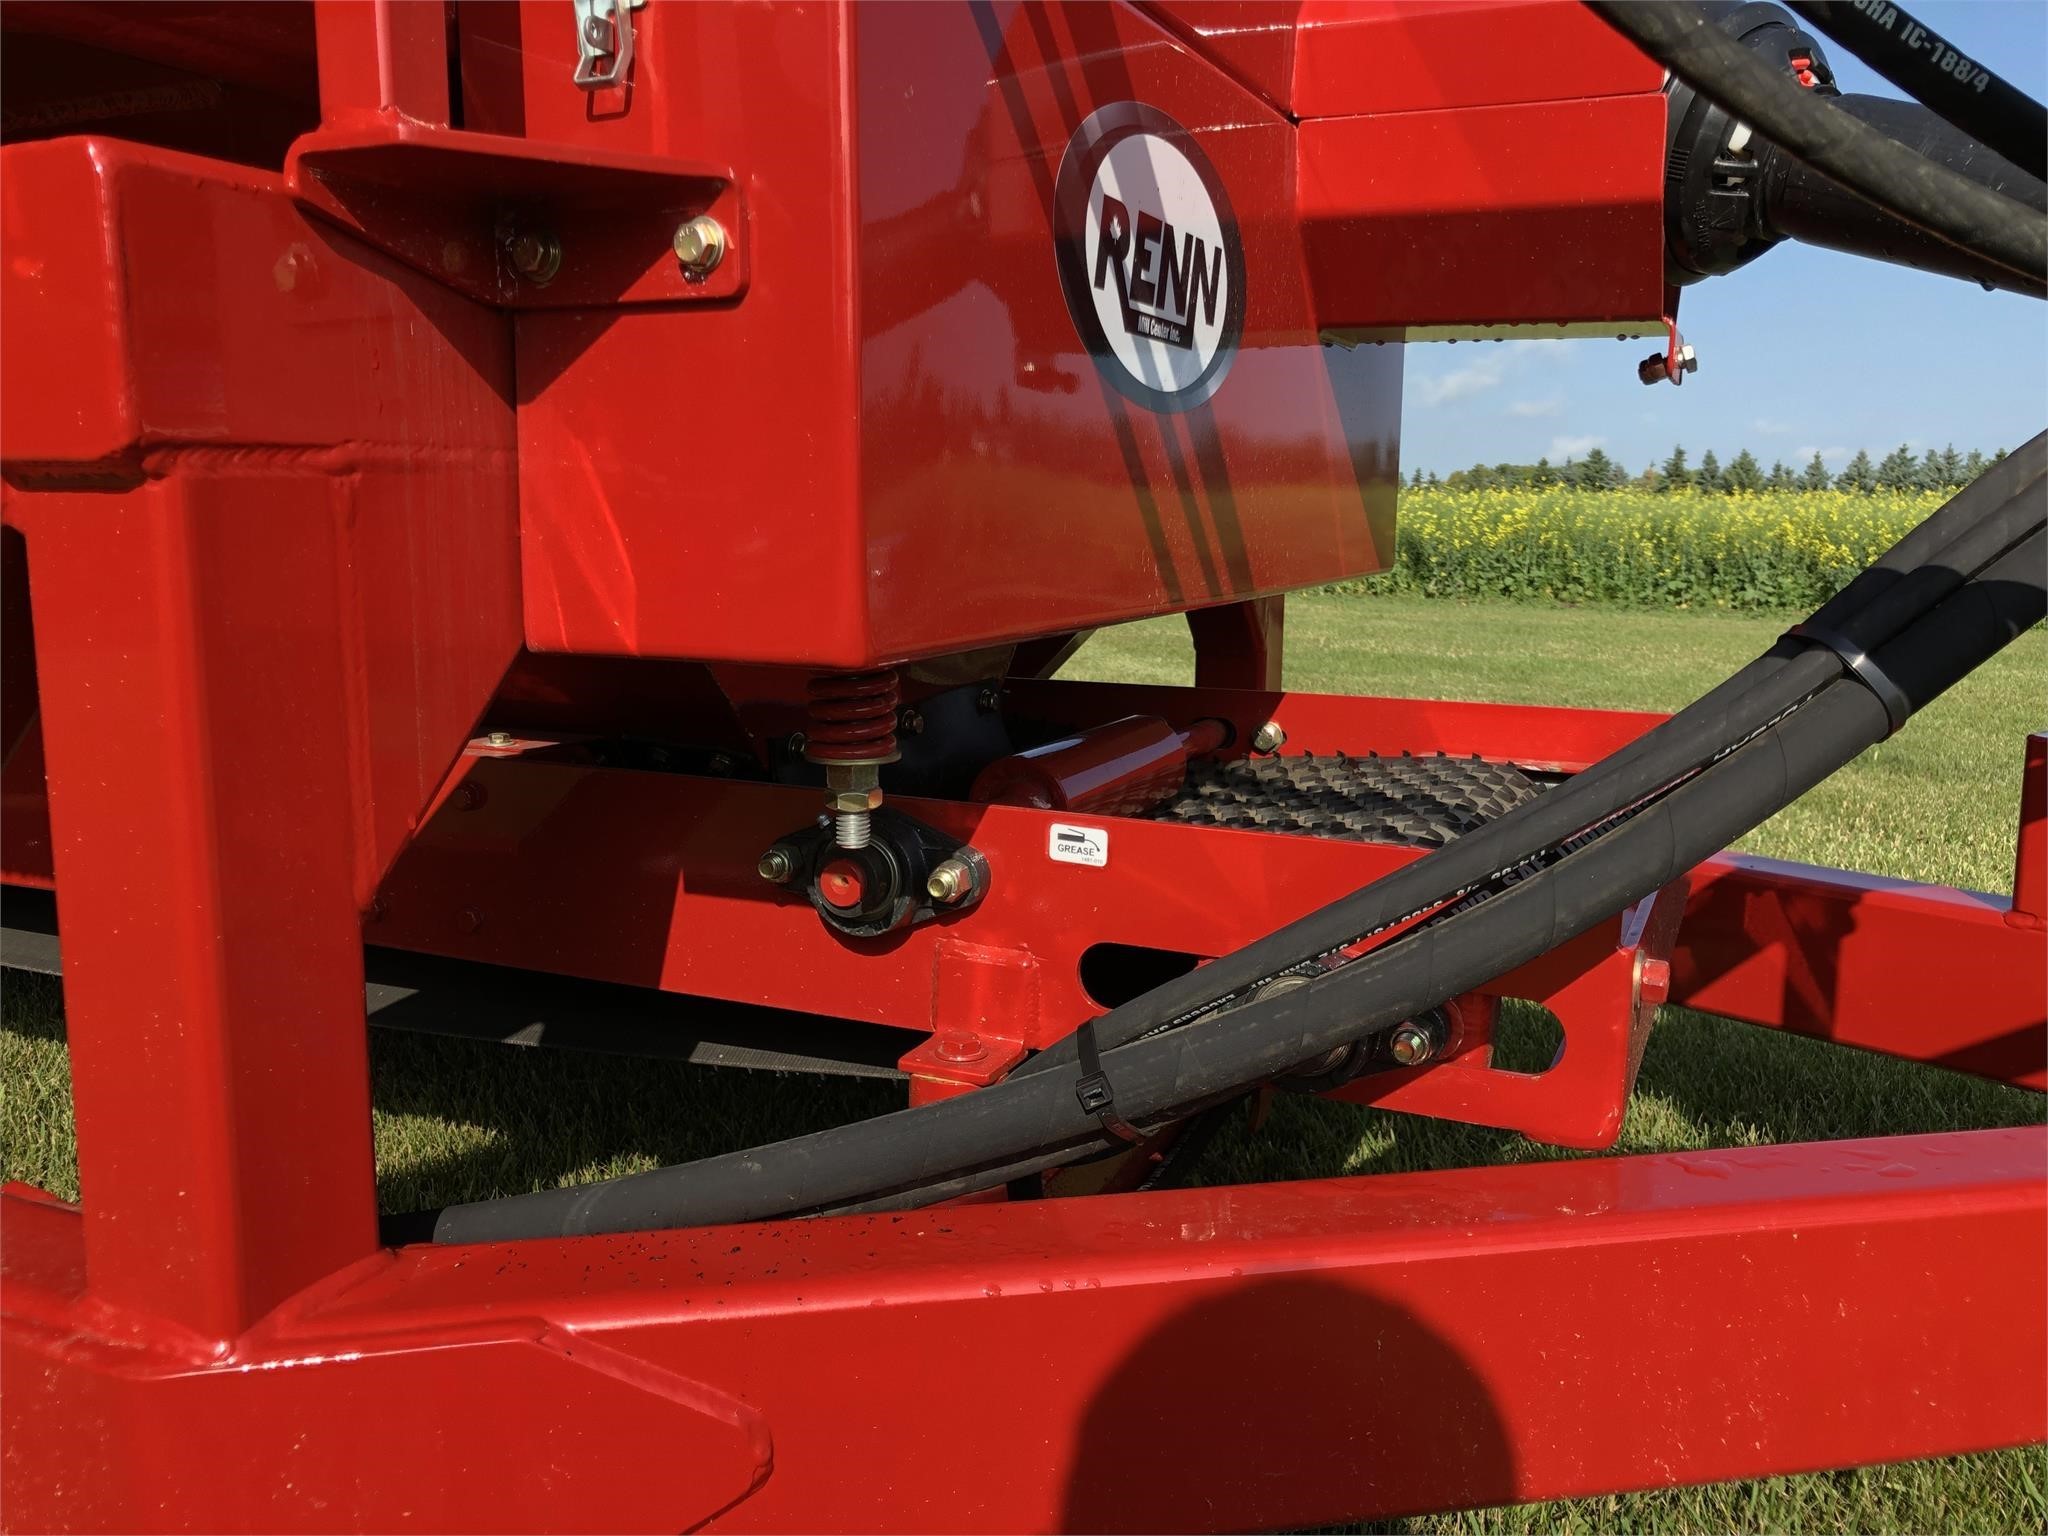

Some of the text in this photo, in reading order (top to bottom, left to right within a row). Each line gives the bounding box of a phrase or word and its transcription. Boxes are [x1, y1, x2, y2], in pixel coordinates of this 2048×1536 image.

[1900, 21, 1990, 93] IC-188/4
[1094, 194, 1222, 328] RENN
[1057, 843, 1094, 856] GREASE
